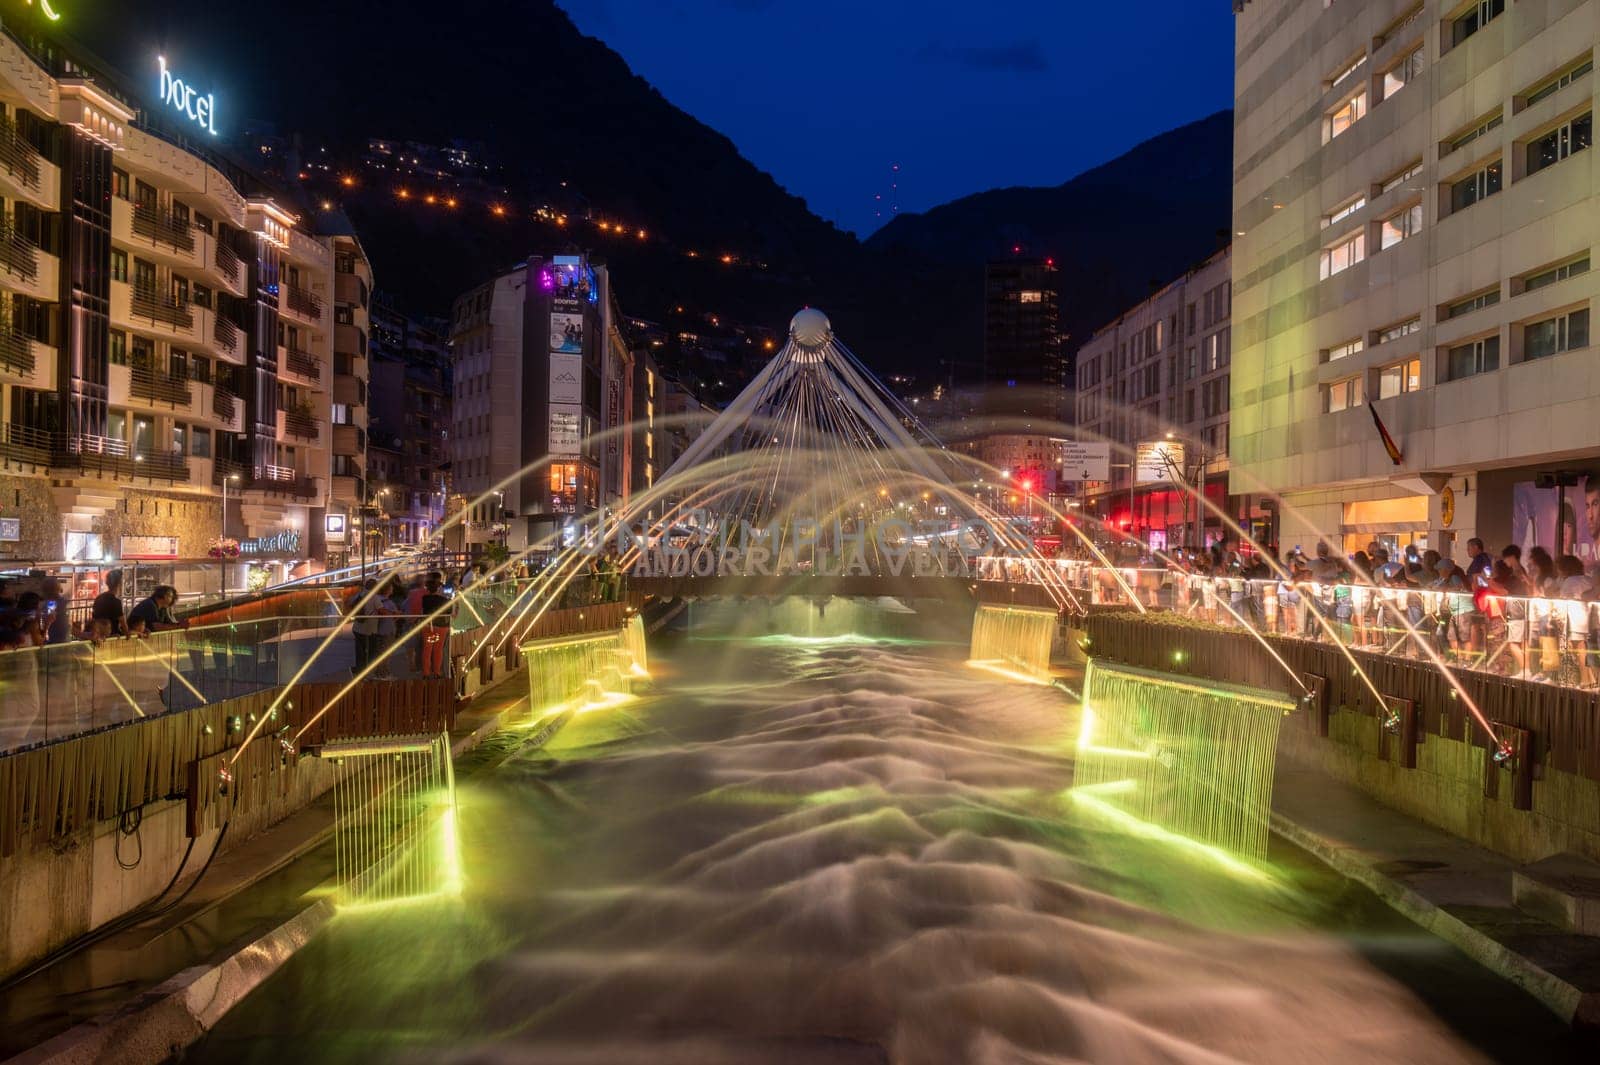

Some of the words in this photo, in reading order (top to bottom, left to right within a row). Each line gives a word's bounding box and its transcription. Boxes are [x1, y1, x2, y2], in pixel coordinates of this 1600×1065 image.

[157, 55, 218, 136] hotel
[632, 545, 802, 577] ANDORRA
[816, 547, 872, 577] LA
[879, 547, 977, 577] VELL
